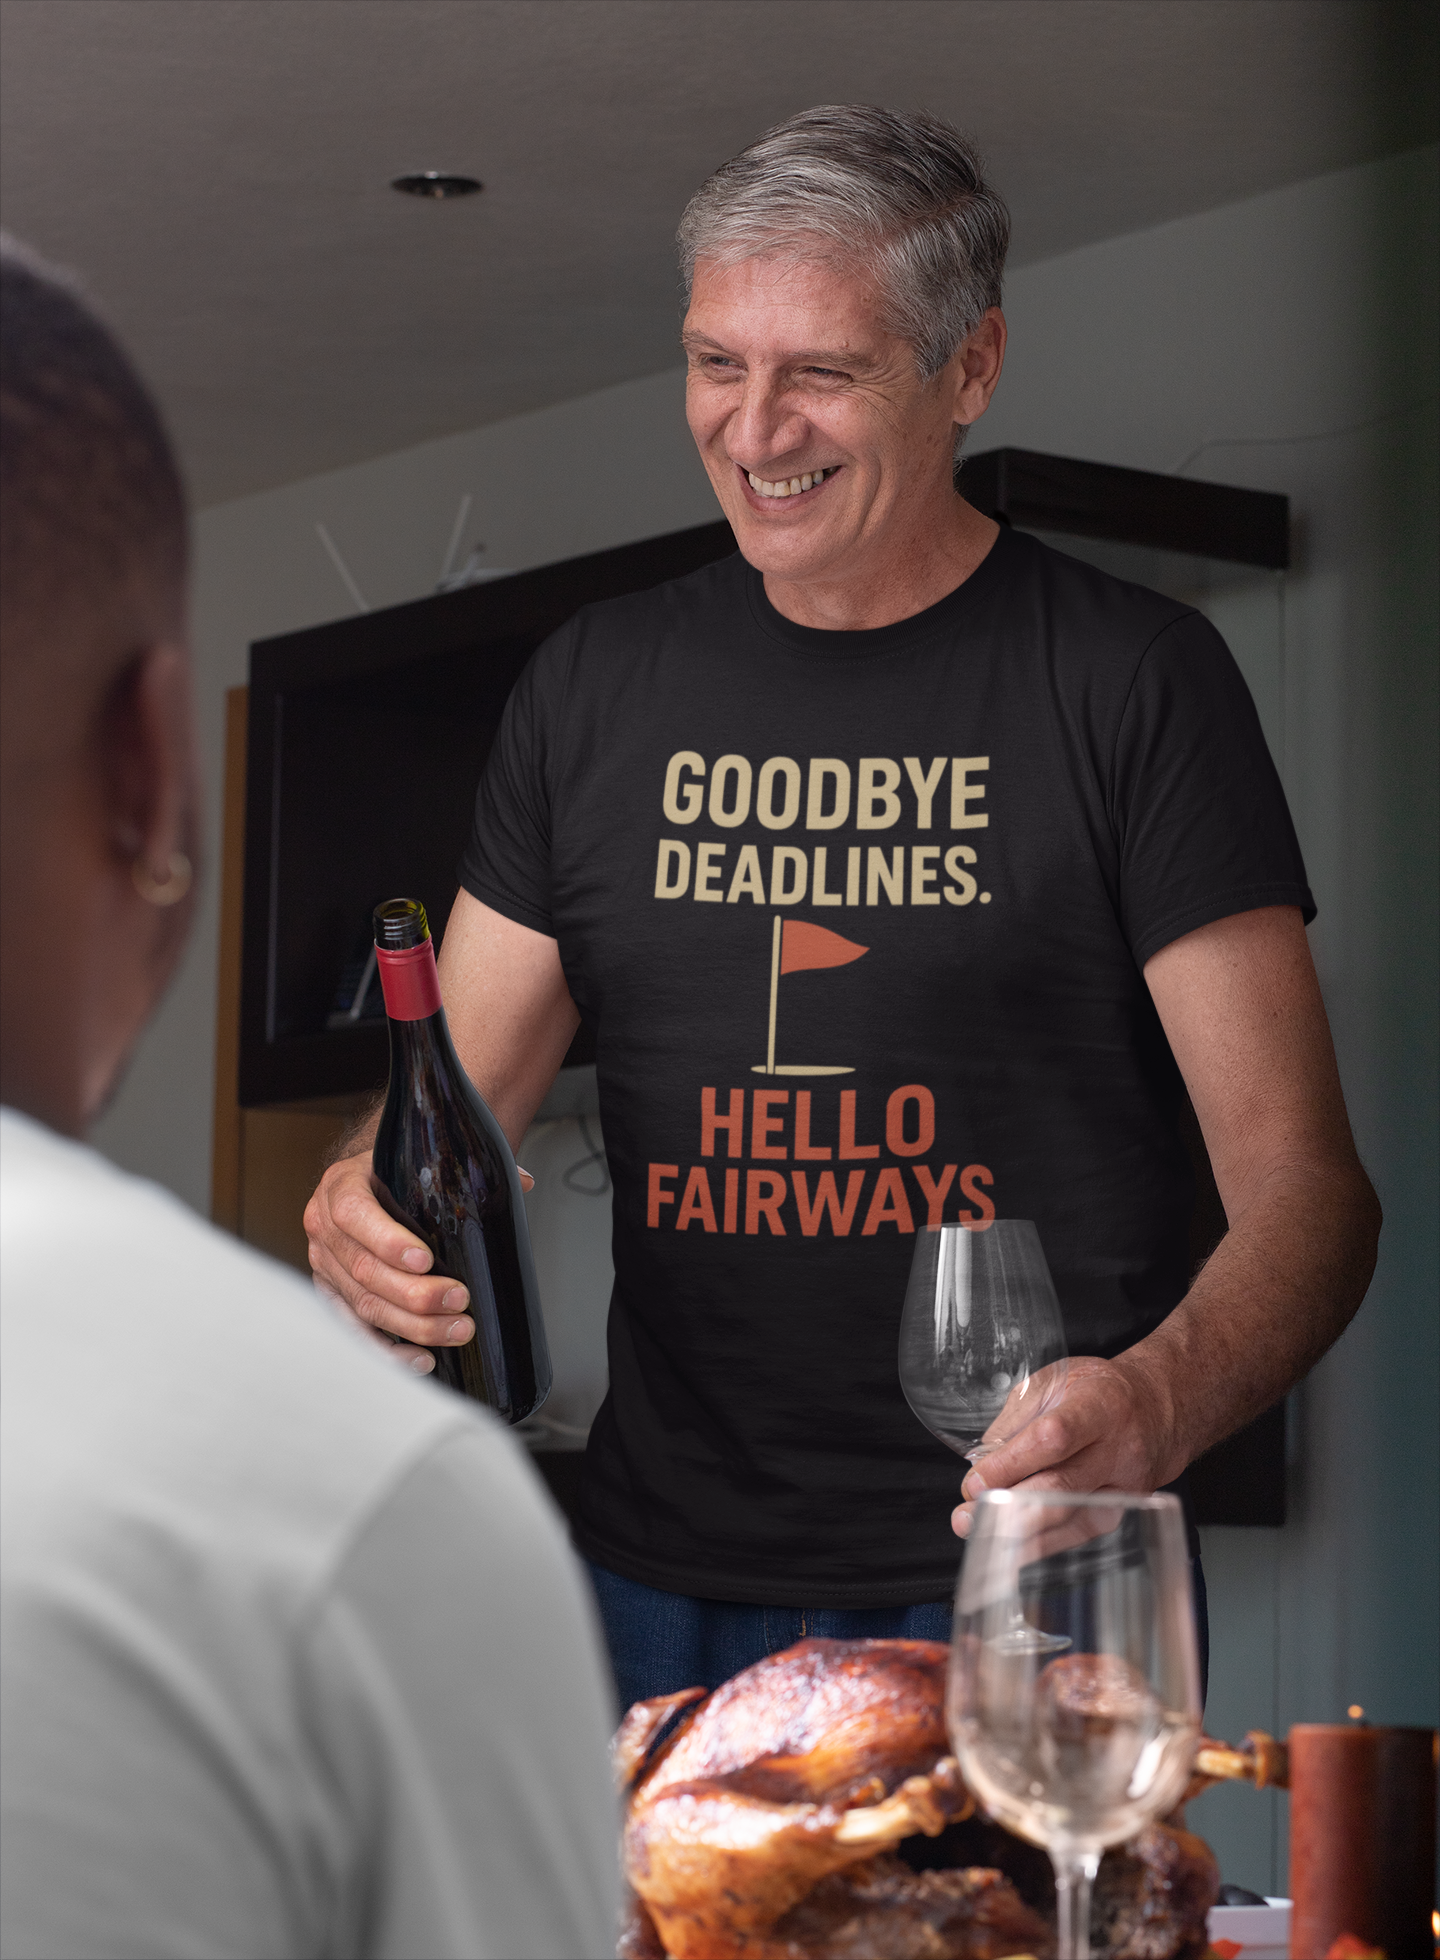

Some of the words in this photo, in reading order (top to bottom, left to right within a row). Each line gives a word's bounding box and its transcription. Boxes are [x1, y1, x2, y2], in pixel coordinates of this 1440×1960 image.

[663, 751, 990, 830] GOODBYE
[654, 839, 992, 906] DEADLINES.
[700, 1084, 936, 1160] HELLO
[647, 1163, 996, 1237] FAIRWAYS
